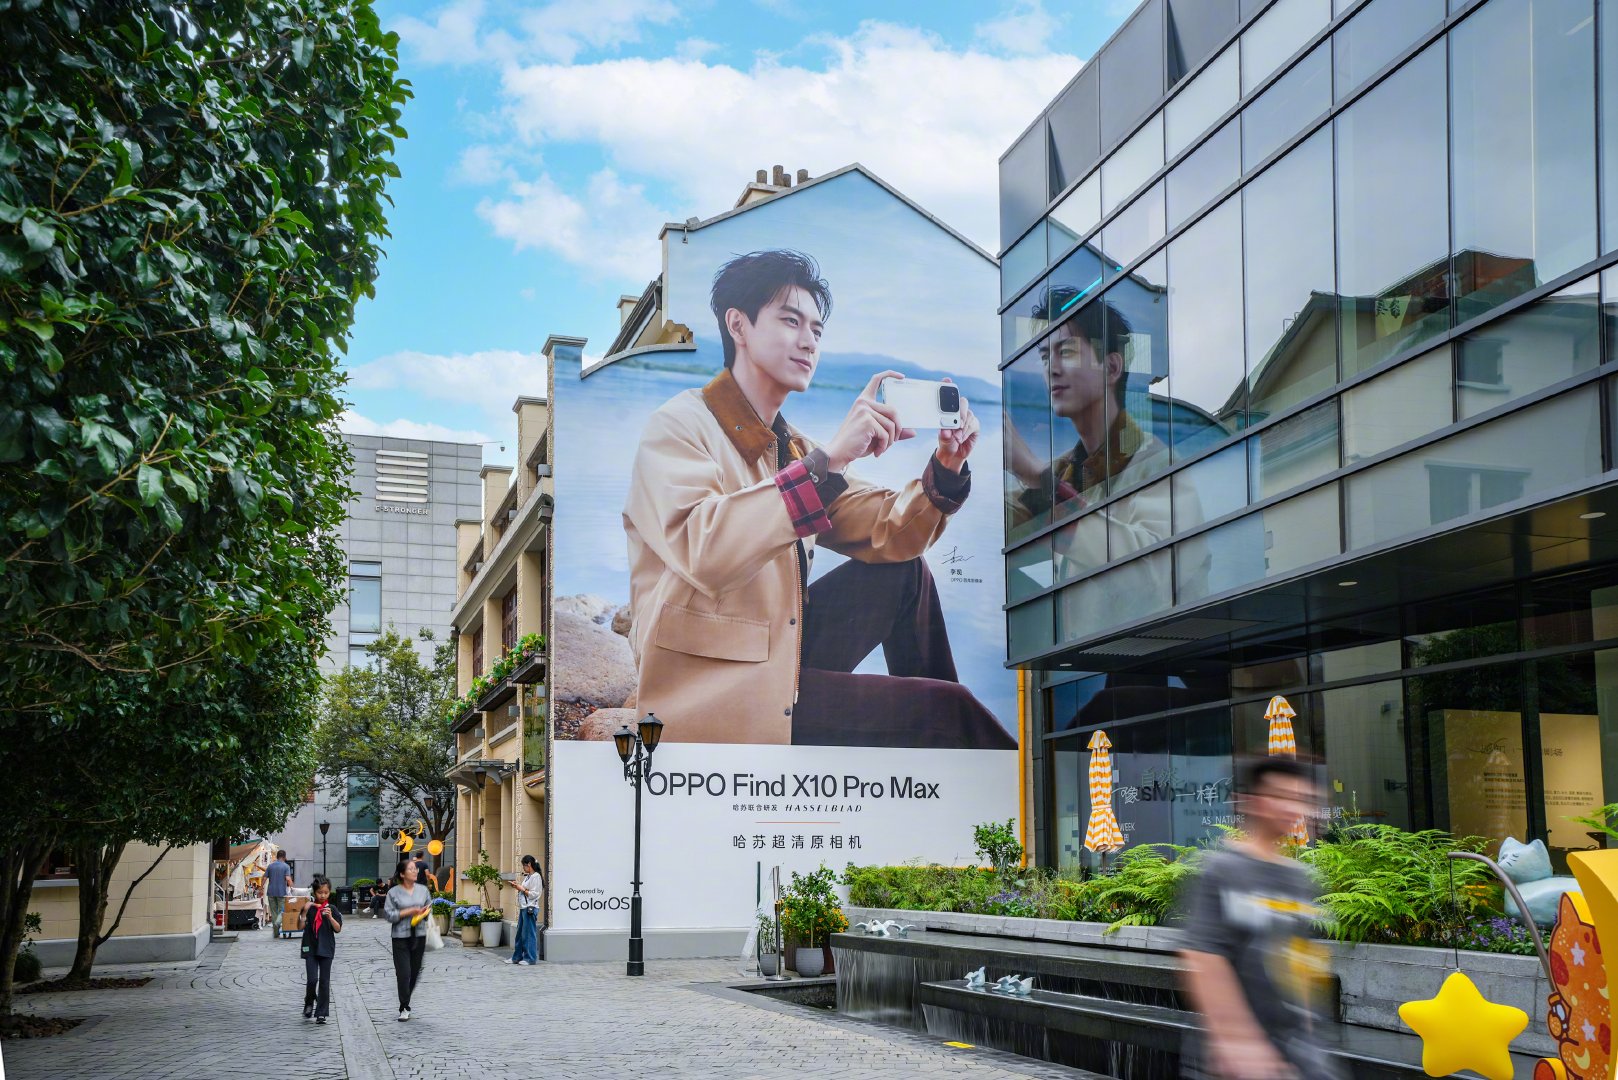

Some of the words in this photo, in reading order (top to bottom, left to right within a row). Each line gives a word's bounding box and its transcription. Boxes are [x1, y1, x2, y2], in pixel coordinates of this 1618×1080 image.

[649, 771, 726, 797] OPPO
[733, 773, 786, 797] Find
[792, 774, 838, 798] X10
[843, 775, 884, 799] Pro
[890, 776, 940, 799] Max
[732, 803, 778, 812] 哈苏联合研发
[785, 804, 862, 812] HASSELBLAD
[1201, 816, 1212, 827] AS
[1215, 814, 1246, 826] NATURE
[733, 834, 862, 849] 哈苏超清原相机
[568, 887, 596, 895] Powered
[597, 888, 605, 896] by
[568, 896, 630, 911] ColorOS
